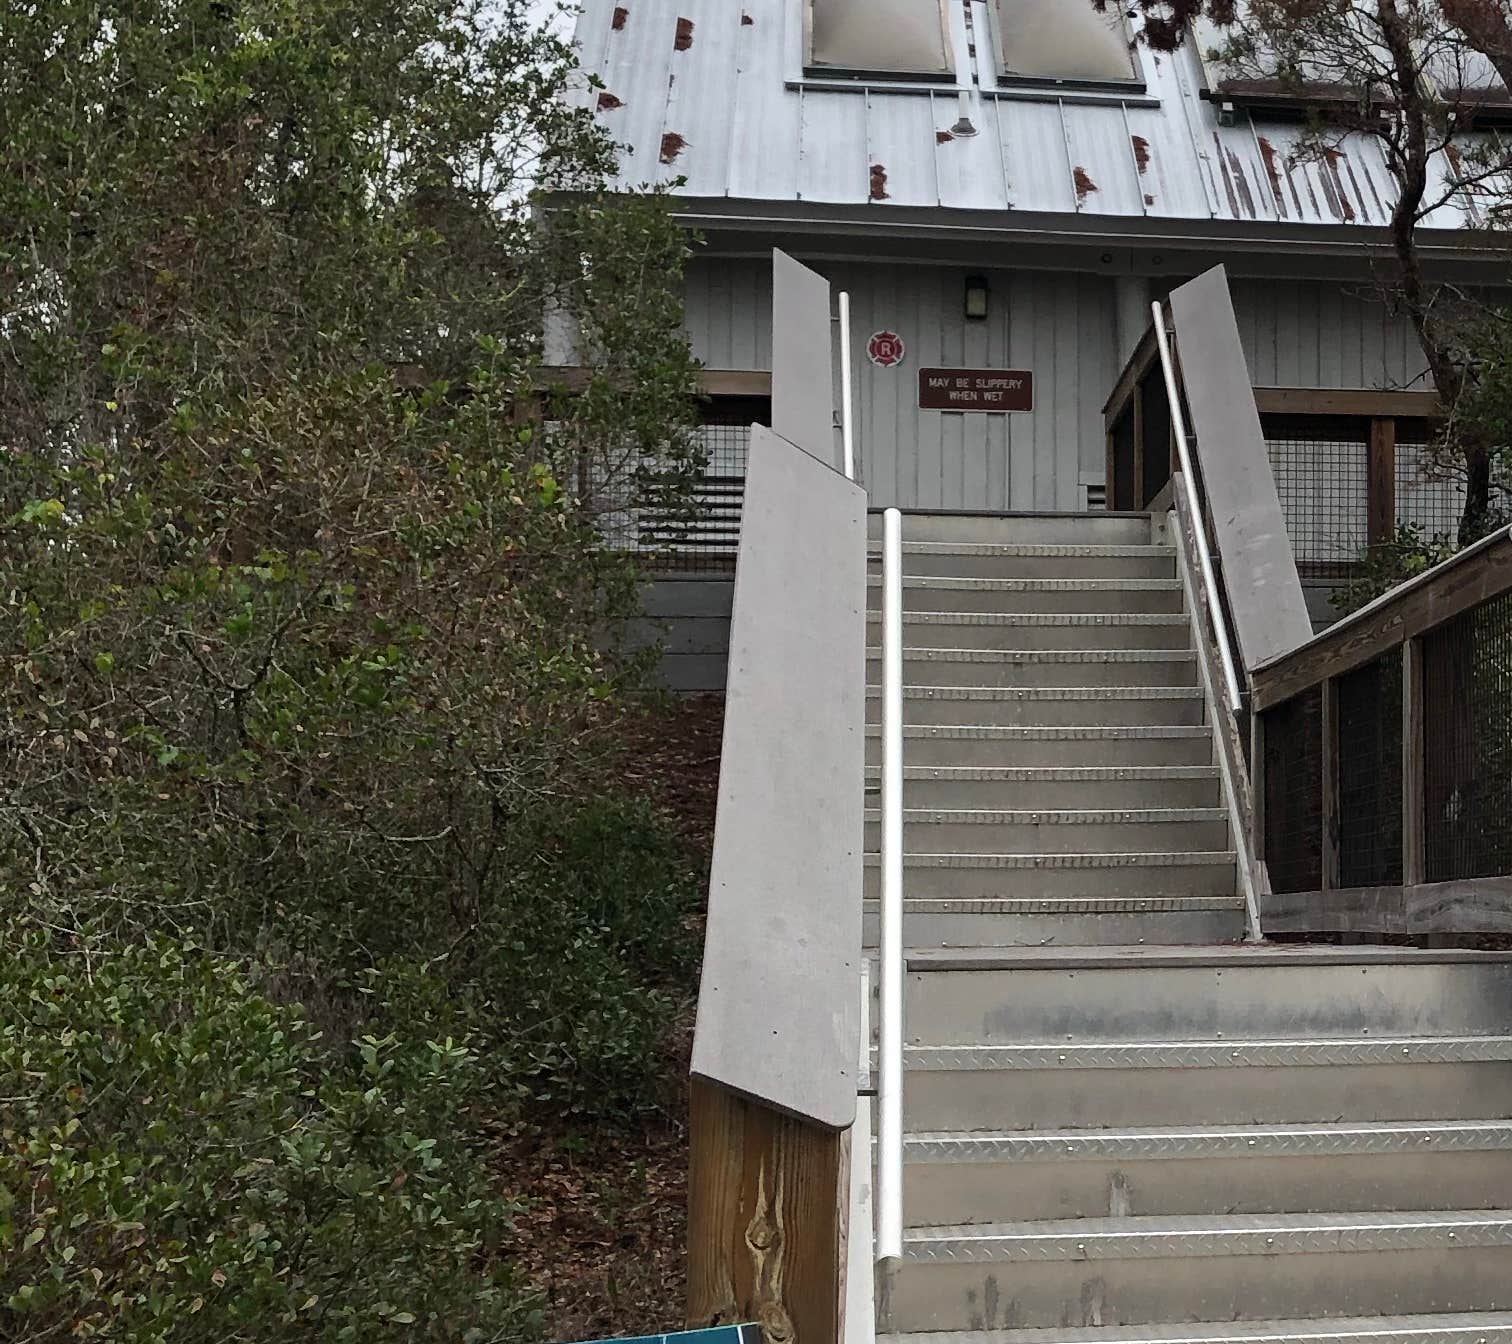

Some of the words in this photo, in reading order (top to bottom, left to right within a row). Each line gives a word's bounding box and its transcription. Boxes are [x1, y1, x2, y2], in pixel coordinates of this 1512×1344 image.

[881, 342, 891, 355] R
[929, 377, 950, 388] MAY
[956, 378, 969, 388] BE
[975, 378, 1023, 389] SLIPPERY
[949, 391, 977, 401] WHEN
[983, 391, 1004, 402] WET
